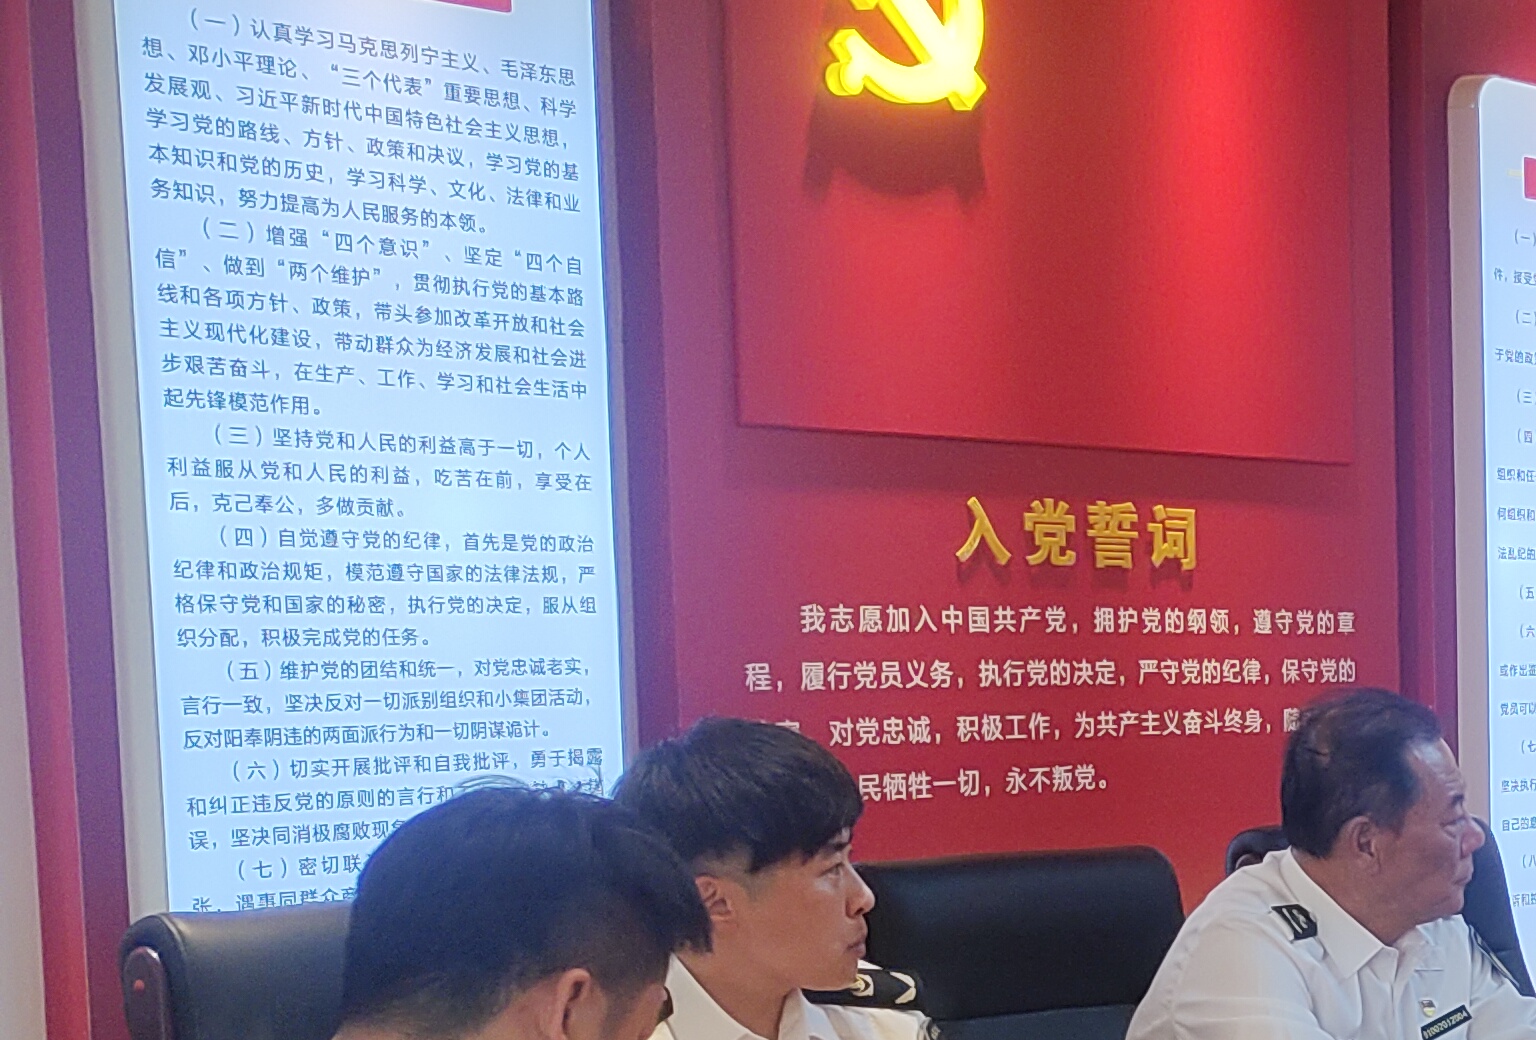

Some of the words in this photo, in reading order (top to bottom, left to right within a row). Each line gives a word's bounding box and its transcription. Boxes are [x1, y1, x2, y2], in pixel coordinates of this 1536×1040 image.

[190, 8, 577, 88] （一）认真学习马克思列宁主义、毛泽东思
[145, 72, 569, 149] 发展观、习近平新时代中国特色社会主义思想，
[146, 108, 579, 182] 学习党的路线、方针、政策和决议，学习党的基
[149, 143, 581, 212] 本知识和党的历史，学习科学、文化、法律和业
[151, 178, 486, 234] 务知识，努力提高为人民服务的本领。
[157, 283, 585, 338] 线和各项方针、政策，带头参加改革开放和社会
[160, 319, 587, 369] 主义现代化建设，带动群众为经济发展和社会进
[162, 354, 588, 400] 步艰苦奋斗，在生产、工作、学习和社会生活中
[163, 389, 322, 417] 起先锋模范作用。
[214, 424, 590, 462] （三）坚持党和人民的利益高于一切，个人
[167, 457, 592, 492] 利益服从党和人民的利益，吃苦在前，享受在
[169, 491, 405, 518] 后，克己奉公，多做贡献。
[220, 527, 595, 554] （四）自觉遵守党的纪律，首先是党的政治
[956, 496, 1196, 571] 入党誓词
[174, 560, 596, 585] 纪律和政治规矩，模范遵守国家的法律法规，严
[175, 593, 597, 615] 格保守党和国家的秘密，执行党的决定，服从组
[800, 603, 1356, 636] 我志愿加入中国共产党，拥护党的纲领，遵守党的章
[177, 627, 431, 649] 织分配，积极完成党的任务。
[227, 658, 589, 682] （五）维护党的团结和统一，对党忠诚老实，
[745, 656, 1356, 692] 程，履行党员义务，执行党的决定，严守党的纪律，保守党的
[182, 688, 590, 717] 言行一致，坚决反对一切派别组织和小集团活动，
[183, 720, 550, 750] 反对阳奉阴违的两面派行为和一切阴谋诡计。
[238, 853, 365, 882] （七）密切联
